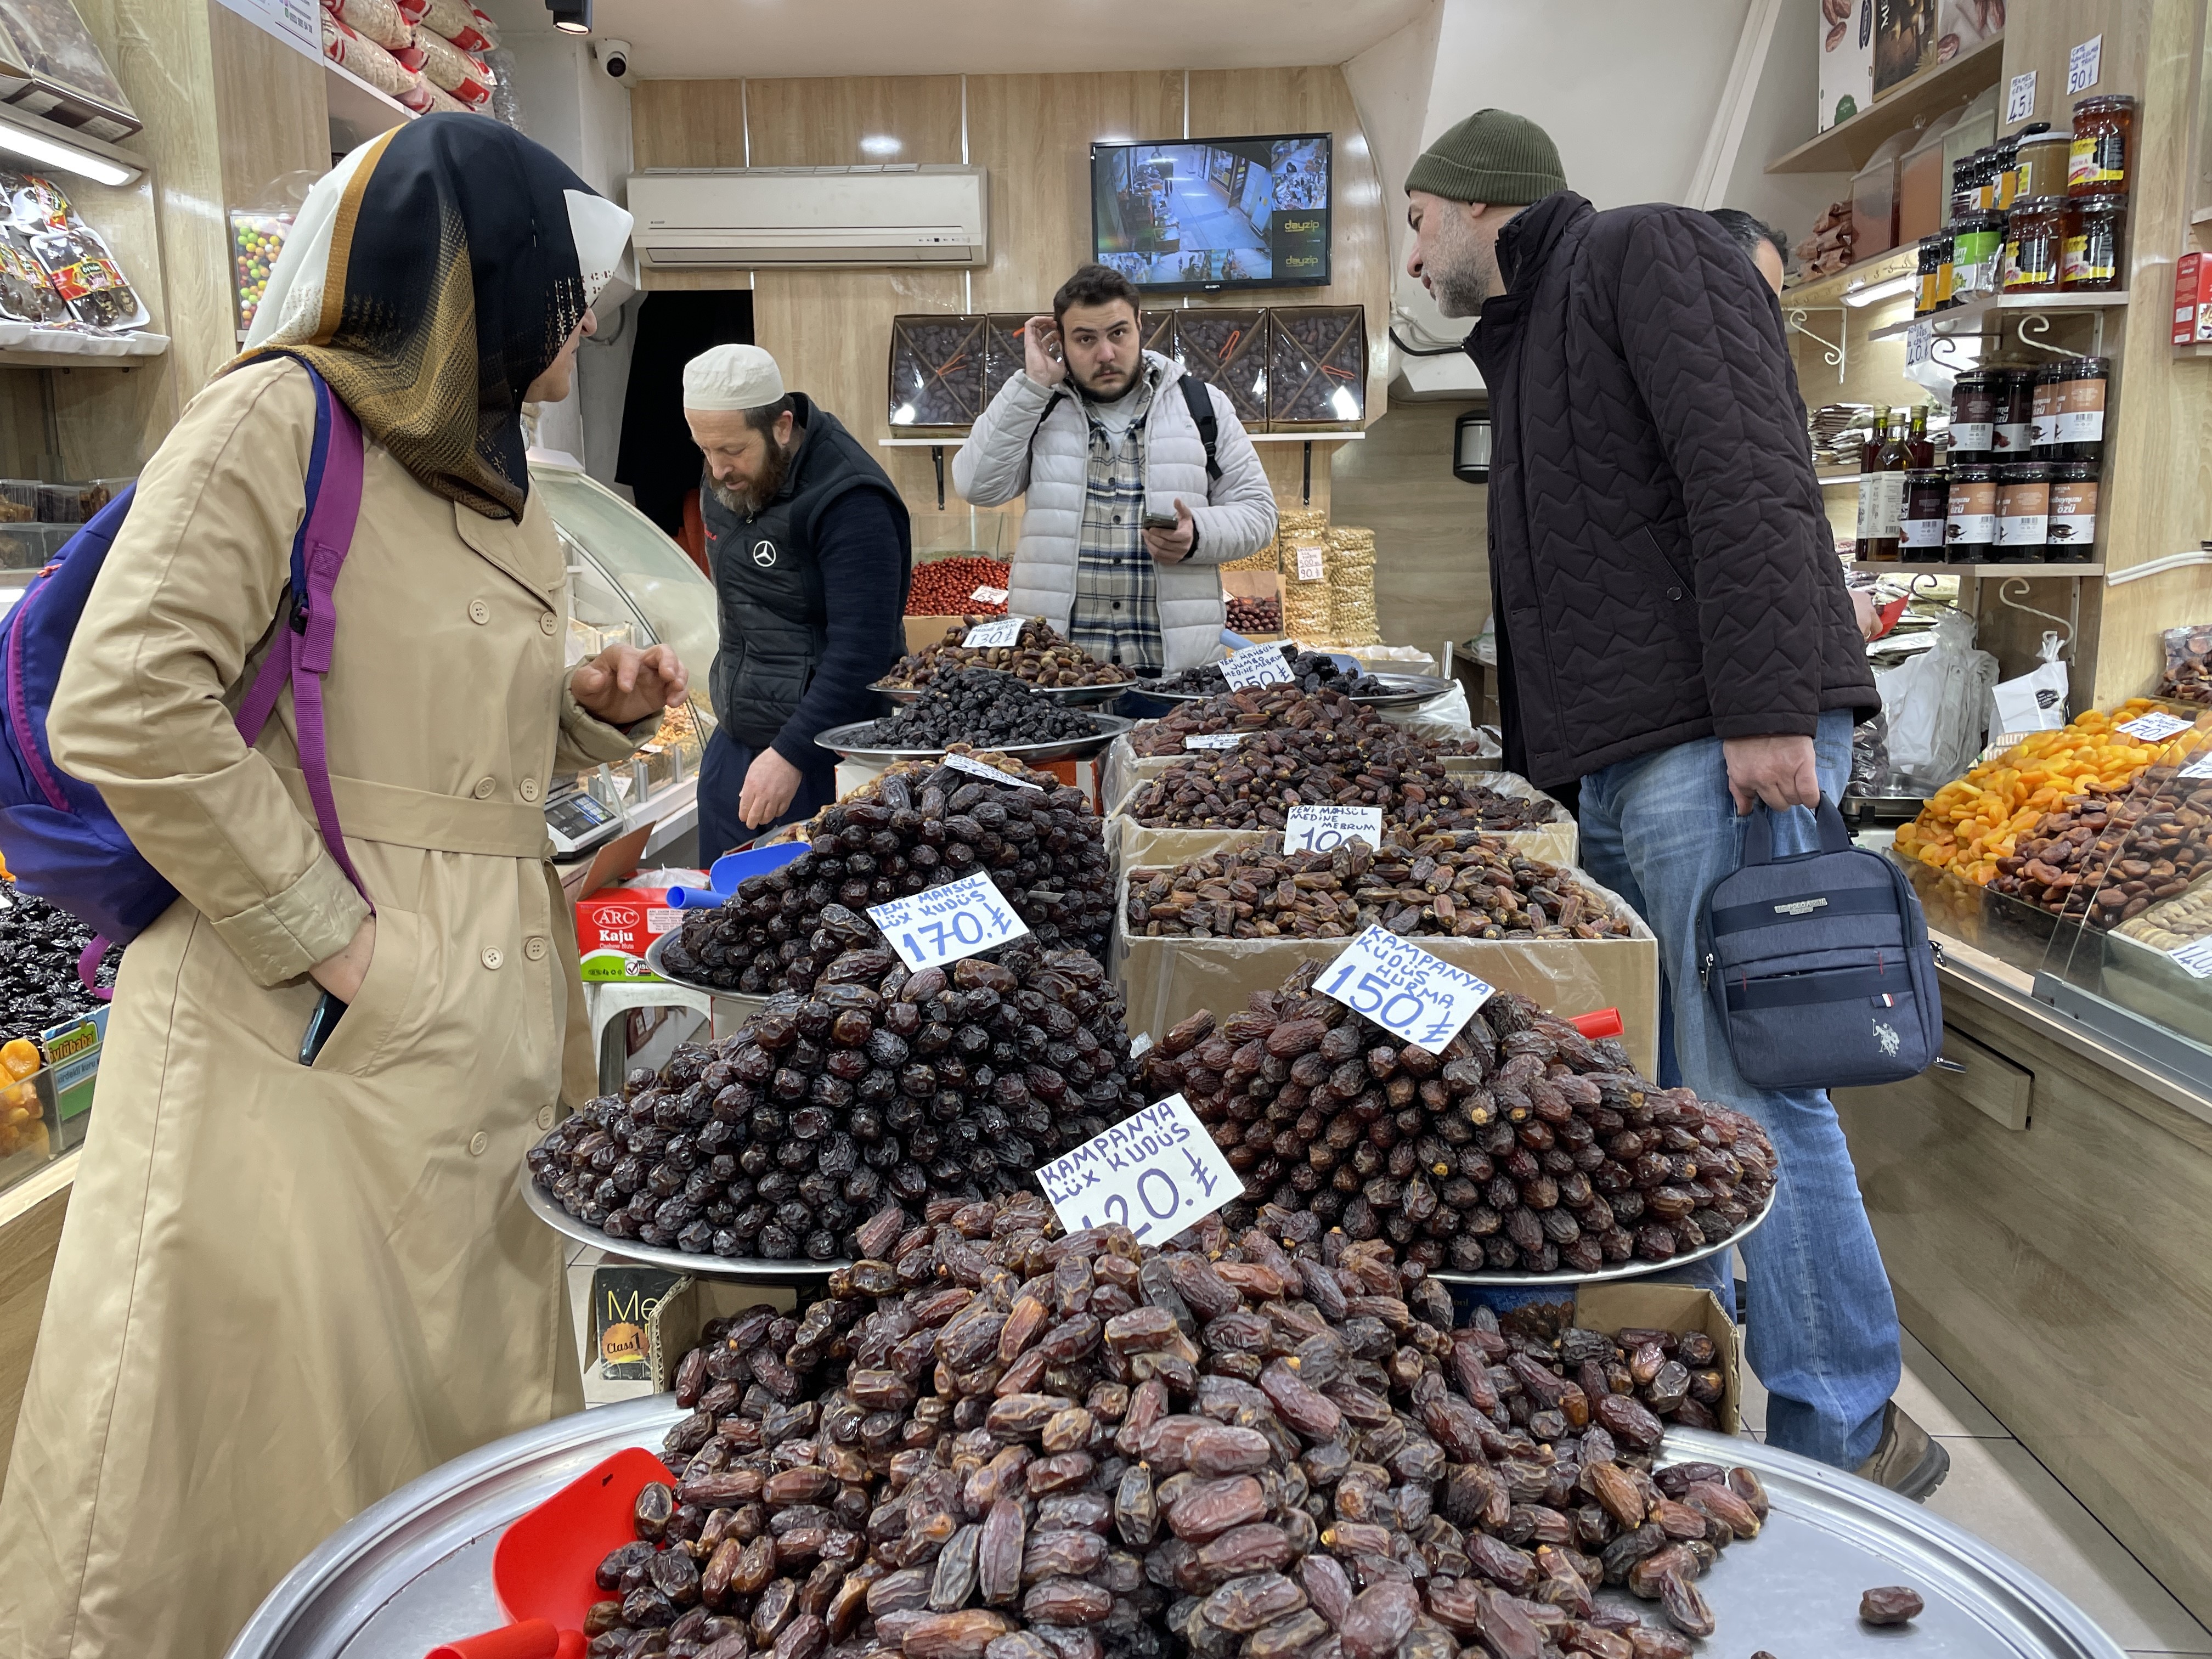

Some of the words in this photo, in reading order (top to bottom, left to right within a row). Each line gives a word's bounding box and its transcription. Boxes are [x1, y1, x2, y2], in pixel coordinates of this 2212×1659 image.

[2057, 504, 2076, 514] özü
[1230, 657, 1264, 670] JUMBO
[1321, 822, 1375, 831] MEBRUM
[599, 909, 635, 924] ARC
[876, 912, 913, 930] LÜX
[918, 890, 986, 916] KUDÜS
[599, 929, 634, 944] Kaju
[1356, 936, 1430, 985] KUDÜS
[1367, 926, 1489, 995] KAMPANYA
[1375, 964, 1455, 1009] HURMA
[81, 1060, 95, 1074] kuru
[1040, 1102, 1176, 1186] KAMPANYA
[1048, 1169, 1101, 1205] LÜX
[1106, 1122, 1190, 1172] KUDÜS
[607, 1340, 634, 1354] Class
[630, 1331, 645, 1351] 1
